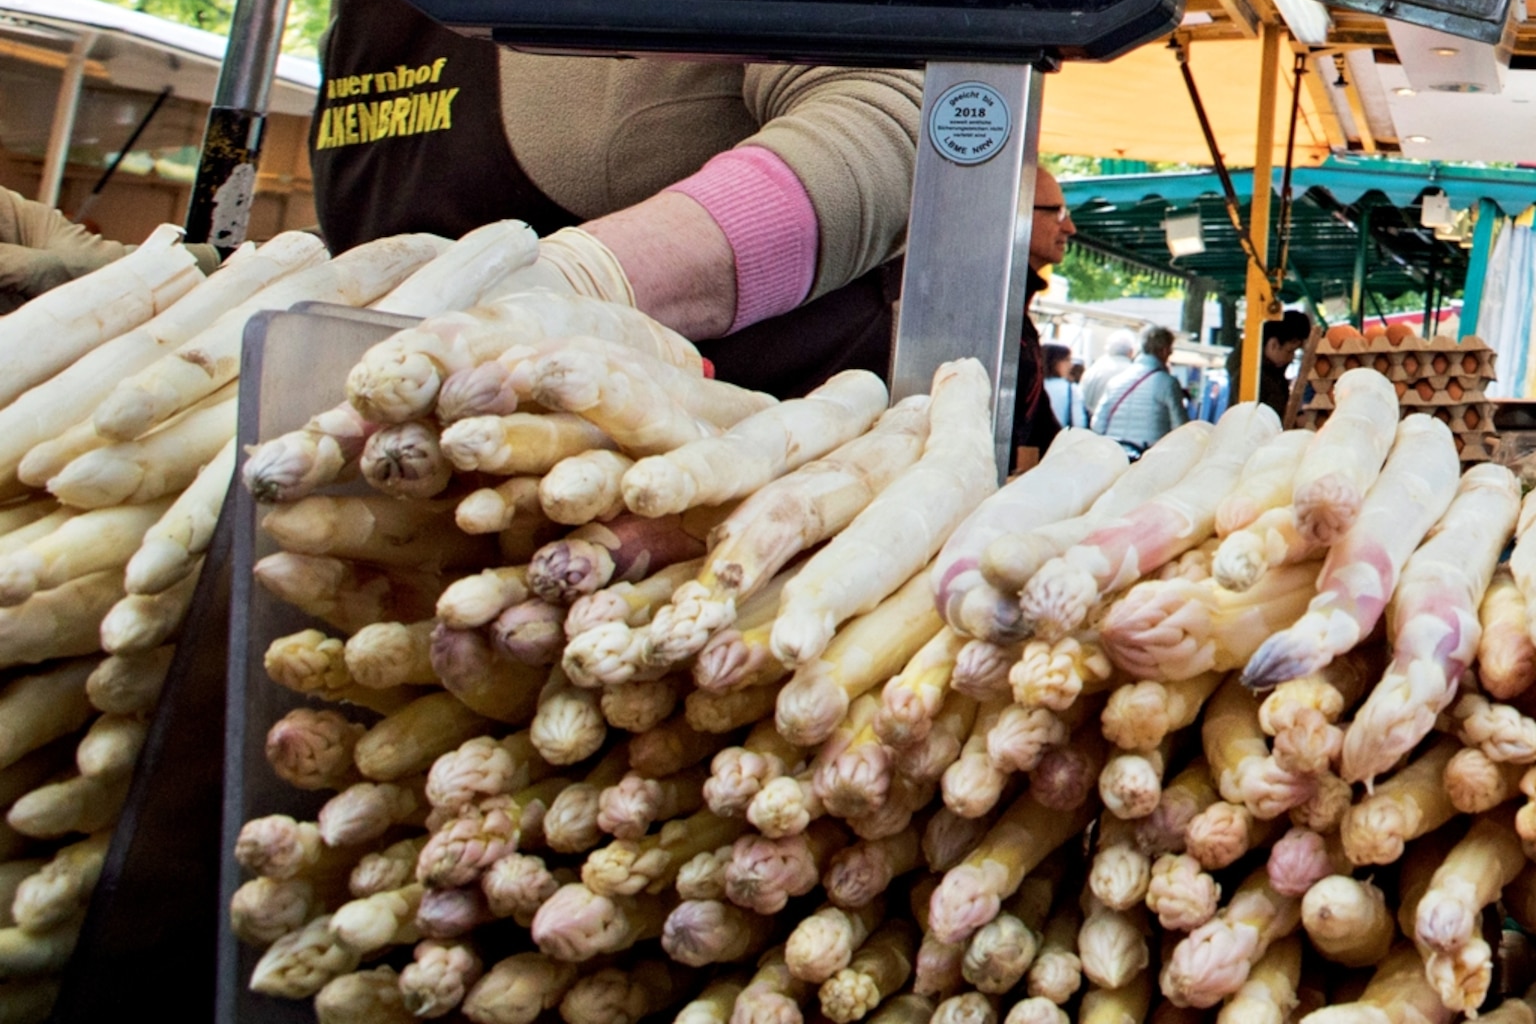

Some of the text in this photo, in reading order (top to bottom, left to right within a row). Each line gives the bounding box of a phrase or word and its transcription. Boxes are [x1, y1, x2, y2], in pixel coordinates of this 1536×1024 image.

[982, 94, 995, 107] bis
[954, 107, 986, 118] 2018
[972, 137, 994, 154] NRW
